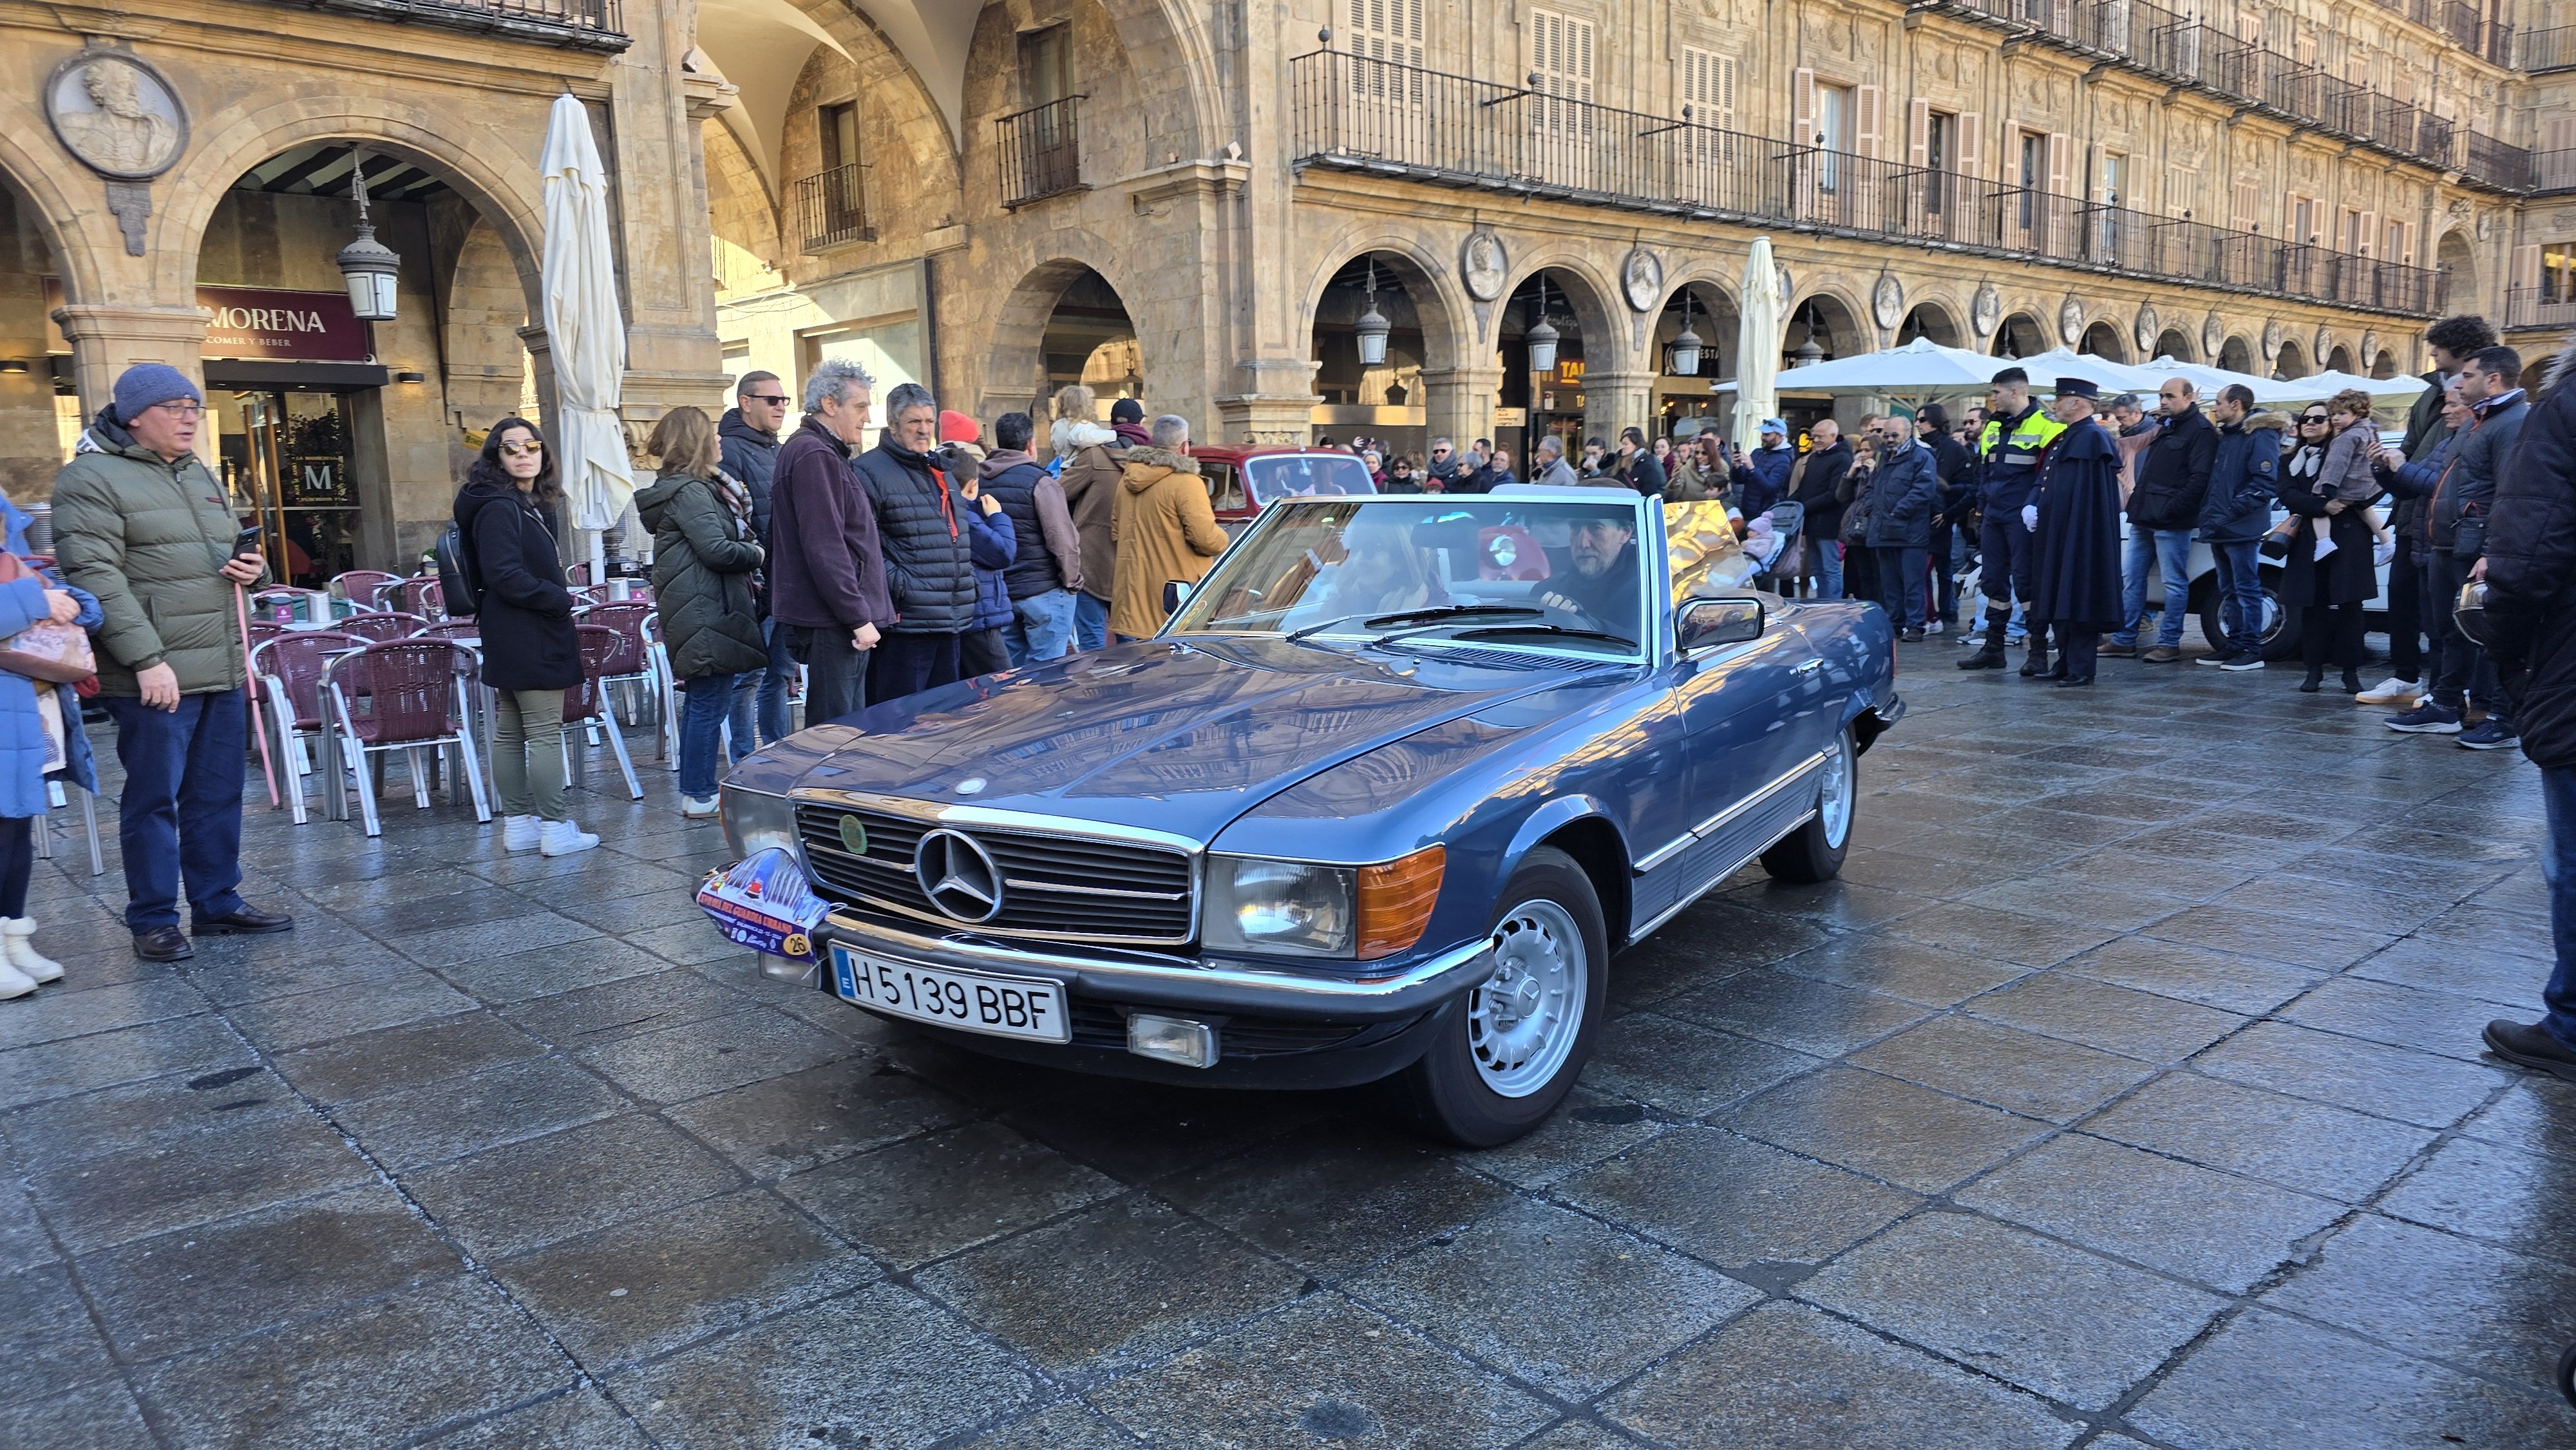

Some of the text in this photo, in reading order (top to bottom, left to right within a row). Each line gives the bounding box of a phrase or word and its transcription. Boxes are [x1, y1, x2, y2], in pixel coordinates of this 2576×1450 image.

[206, 335, 246, 344] COMER
[259, 338, 292, 346] BEBER
[304, 466, 332, 490] M
[763, 916, 792, 934] URBANO
[790, 936, 807, 953] 26
[842, 977, 851, 990] E
[851, 958, 1050, 1030] H 5139 BBF
